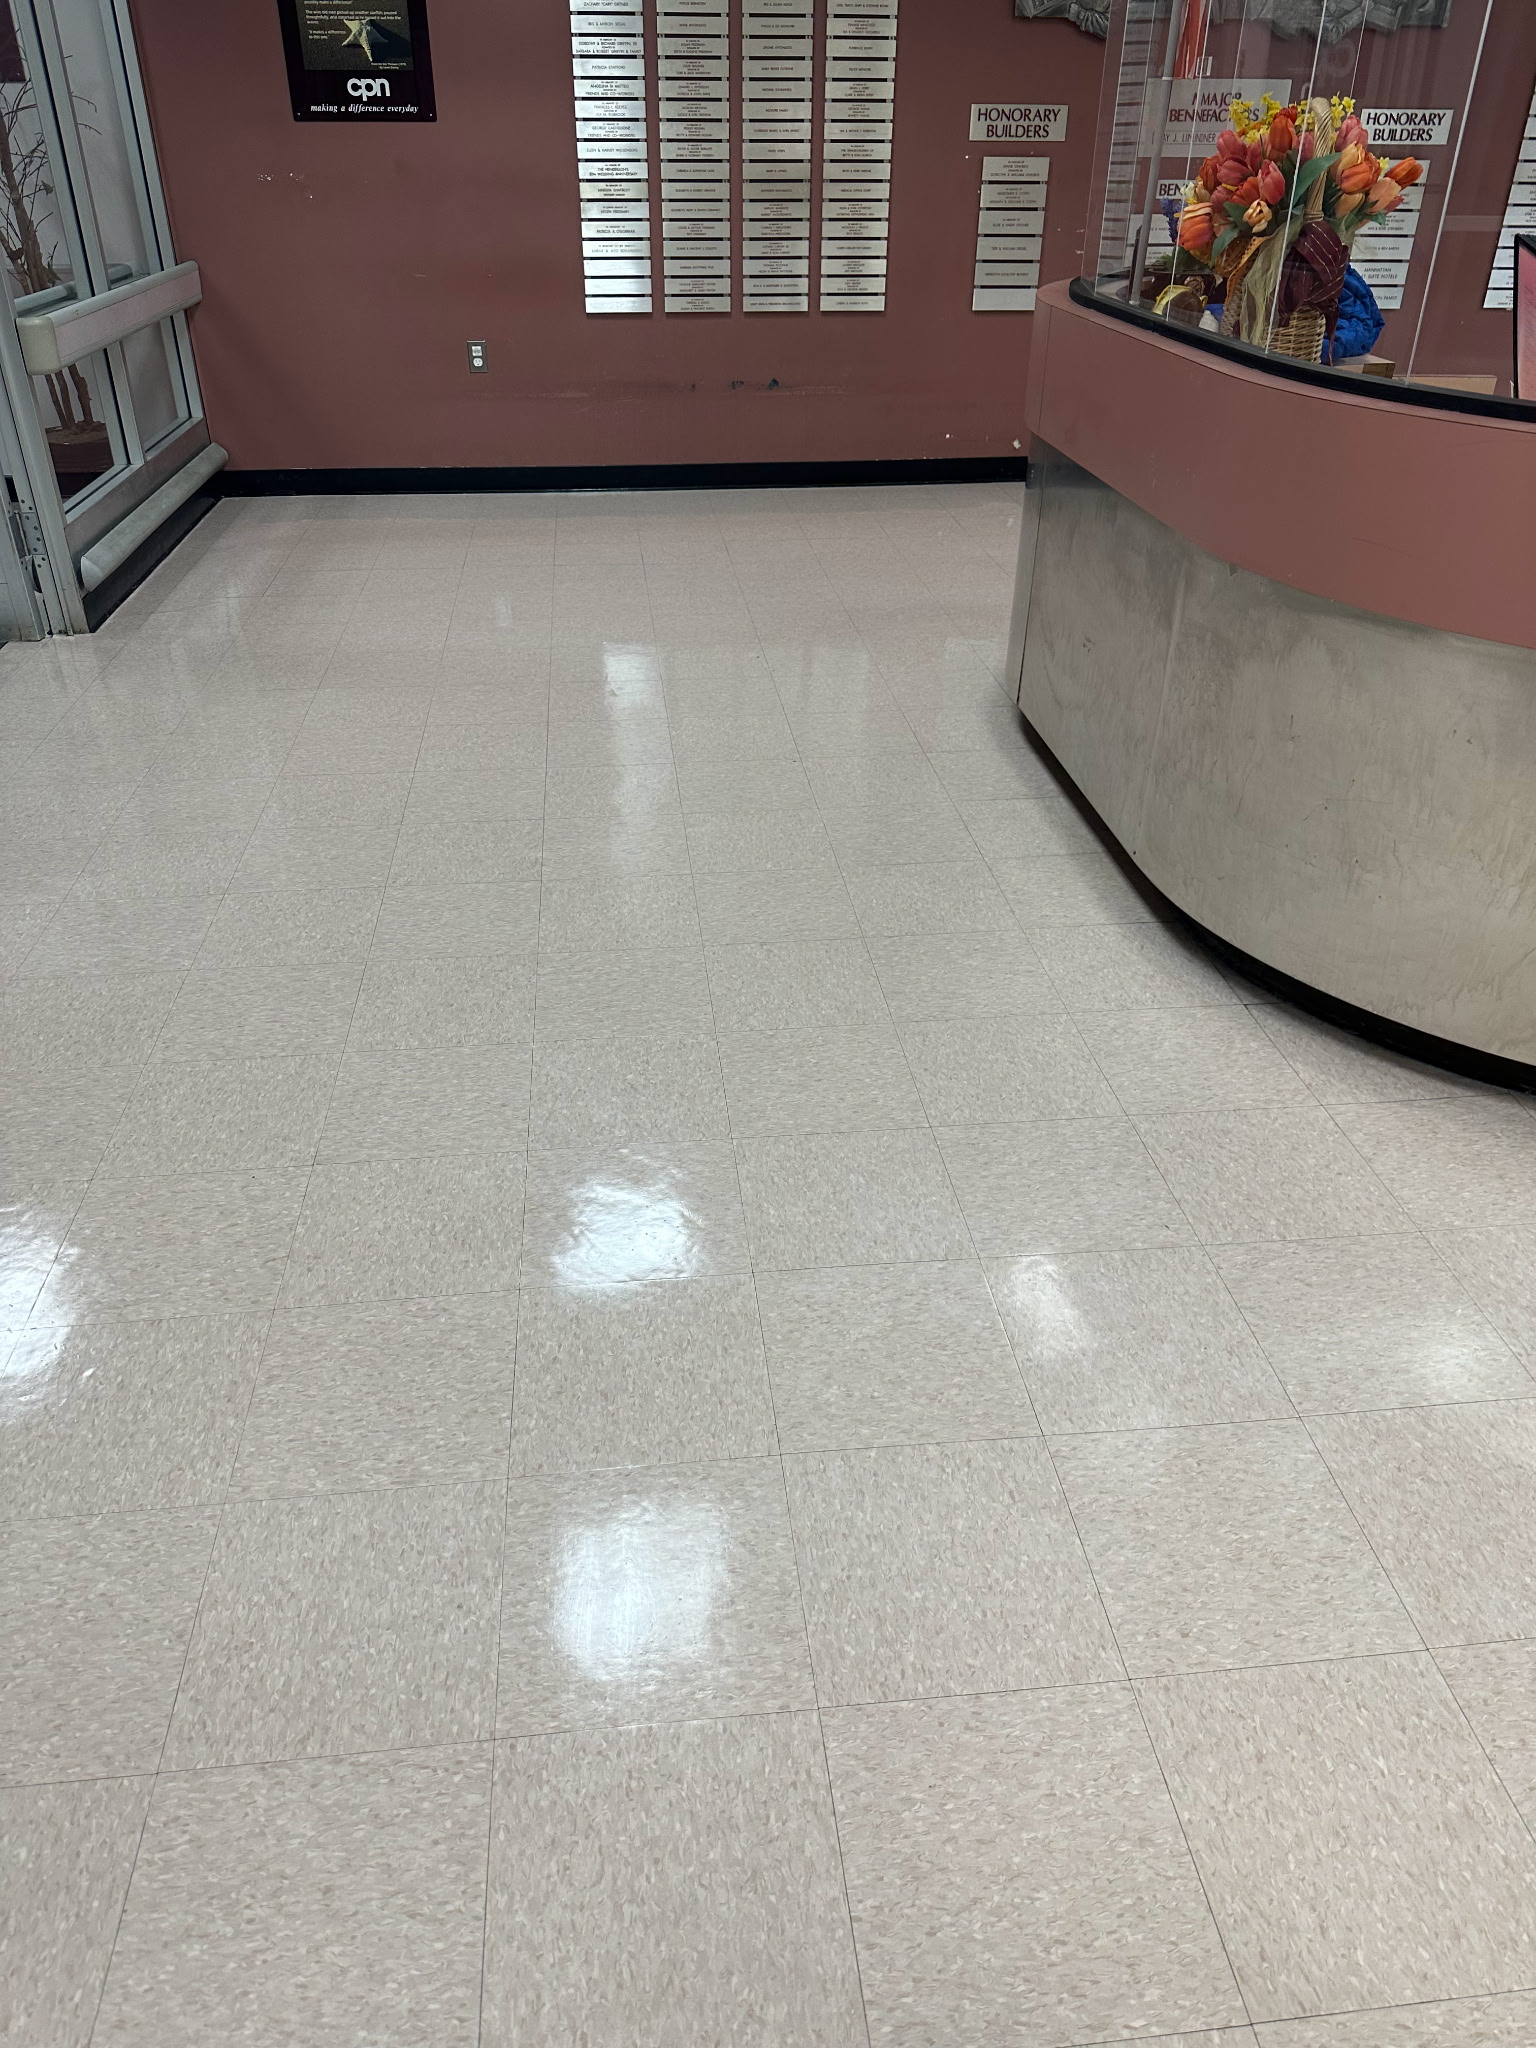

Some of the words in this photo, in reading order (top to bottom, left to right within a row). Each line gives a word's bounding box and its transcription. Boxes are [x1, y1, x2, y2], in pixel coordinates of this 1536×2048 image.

[347, 78, 390, 101] cpn
[311, 104, 338, 112] making
[348, 104, 384, 112] difference
[387, 104, 419, 113] everyday
[977, 107, 1061, 122] HONORARY
[1366, 112, 1446, 126] HONORARY
[986, 124, 1050, 139] BUILDERS
[1373, 128, 1434, 142] BUILDERS
